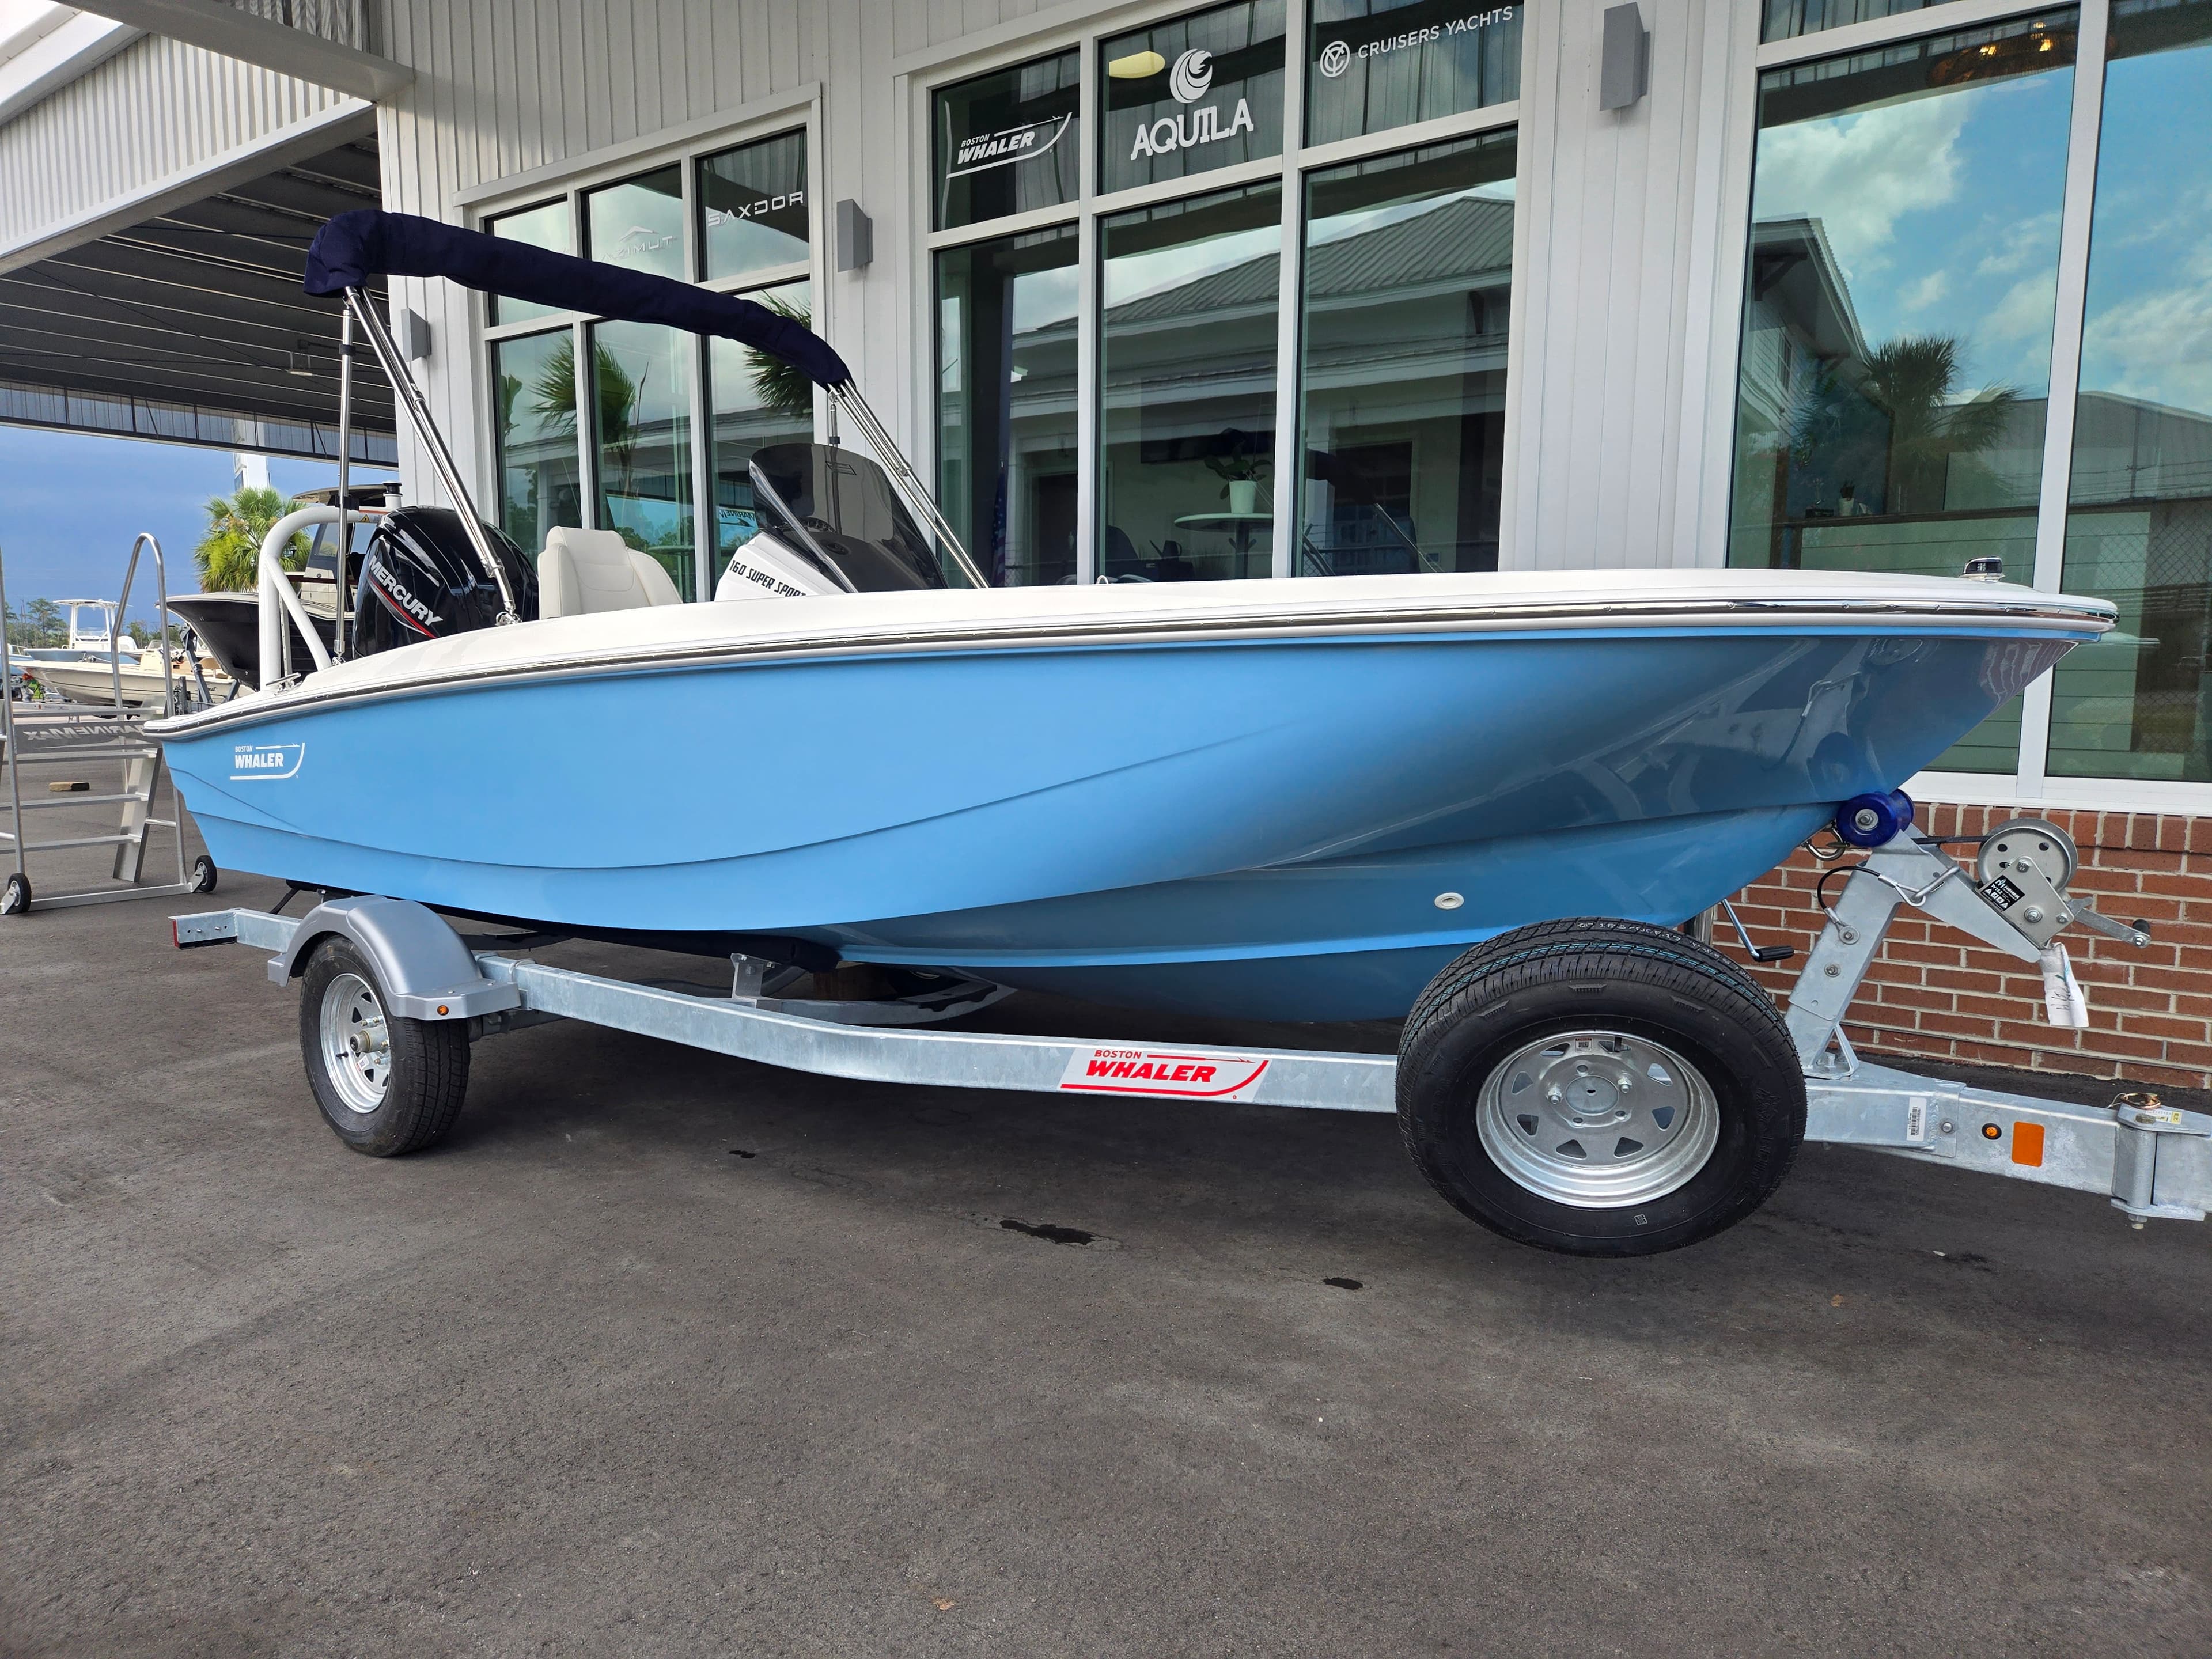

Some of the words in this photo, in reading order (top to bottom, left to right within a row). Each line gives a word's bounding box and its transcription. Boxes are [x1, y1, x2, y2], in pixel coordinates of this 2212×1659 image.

[1358, 25, 1440, 59] CRUISERS
[1445, 6, 1513, 36] YACHTS
[961, 133, 990, 147] BOSTON
[1130, 97, 1254, 161] AQUILA
[957, 131, 1035, 165] WHALER
[707, 191, 804, 226] SAXDOR
[601, 235, 673, 262] AZIMUT
[729, 560, 747, 575] 160
[746, 568, 775, 589] SUPER
[369, 555, 443, 626] MERCURY
[235, 753, 283, 768] WHALER
[1094, 1050, 1142, 1059] BOSTON
[1086, 1060, 1217, 1082] WHALER
